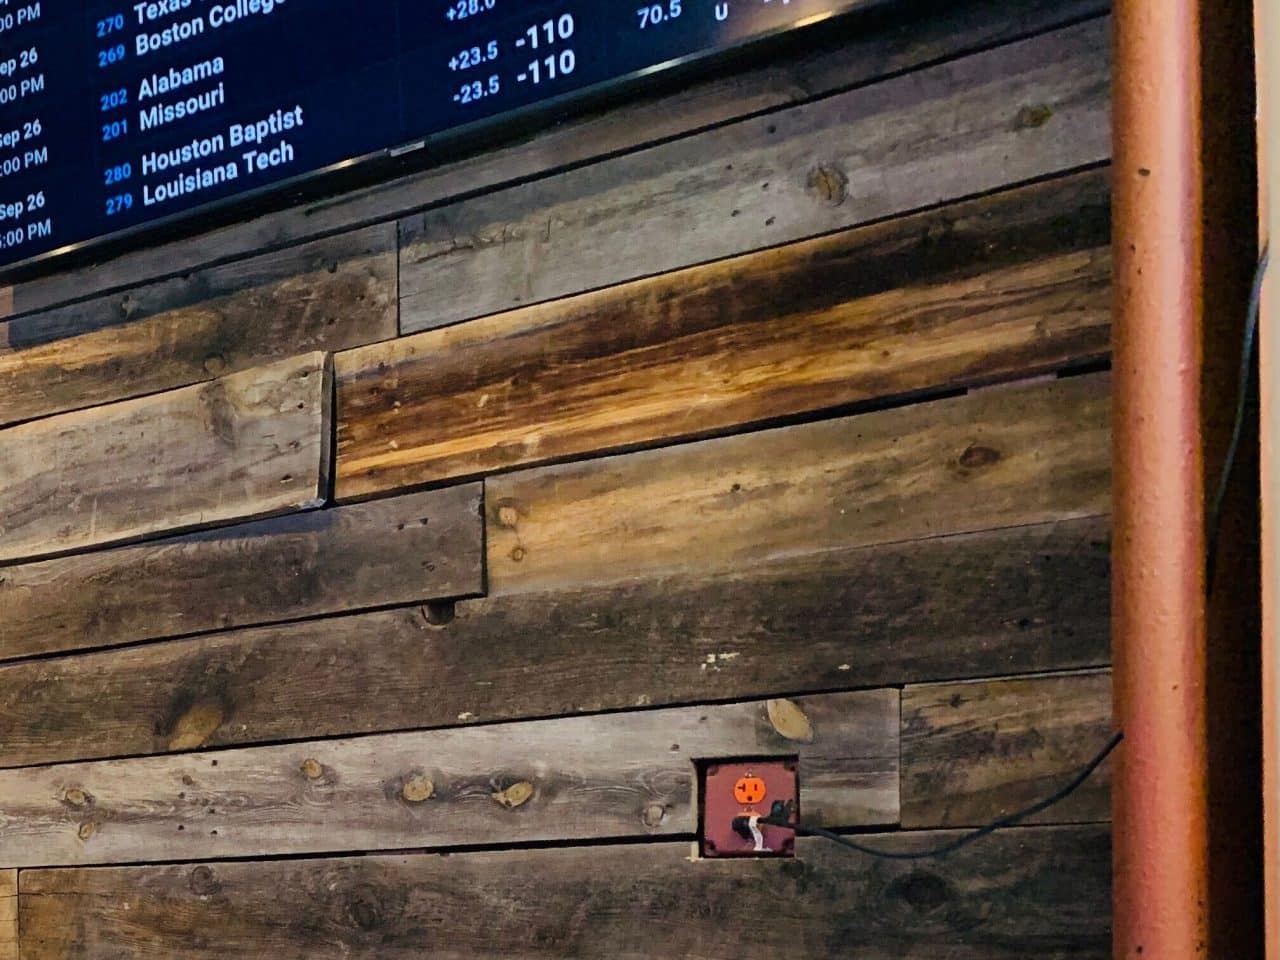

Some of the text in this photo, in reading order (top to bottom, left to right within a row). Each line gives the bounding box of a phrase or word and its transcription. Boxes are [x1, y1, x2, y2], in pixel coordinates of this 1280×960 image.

[18, 2, 40, 25] PM
[96, 13, 124, 38] 270
[98, 0, 286, 68] 269 Boston Colleg
[448, 14, 574, 71] +23.5 -110
[20, 47, 38, 68] 26
[20, 74, 44, 97] PM
[100, 54, 224, 111] 202 Alabama
[453, 49, 575, 104] -23.5 -110
[102, 82, 225, 141] 201 Missouri
[23, 118, 42, 137] 26
[24, 146, 48, 168] PM
[104, 105, 304, 186] 280 Houston Baptist
[106, 140, 294, 216] 279 Louisiana Tech
[26, 191, 45, 209] 26
[27, 218, 52, 240] PM
